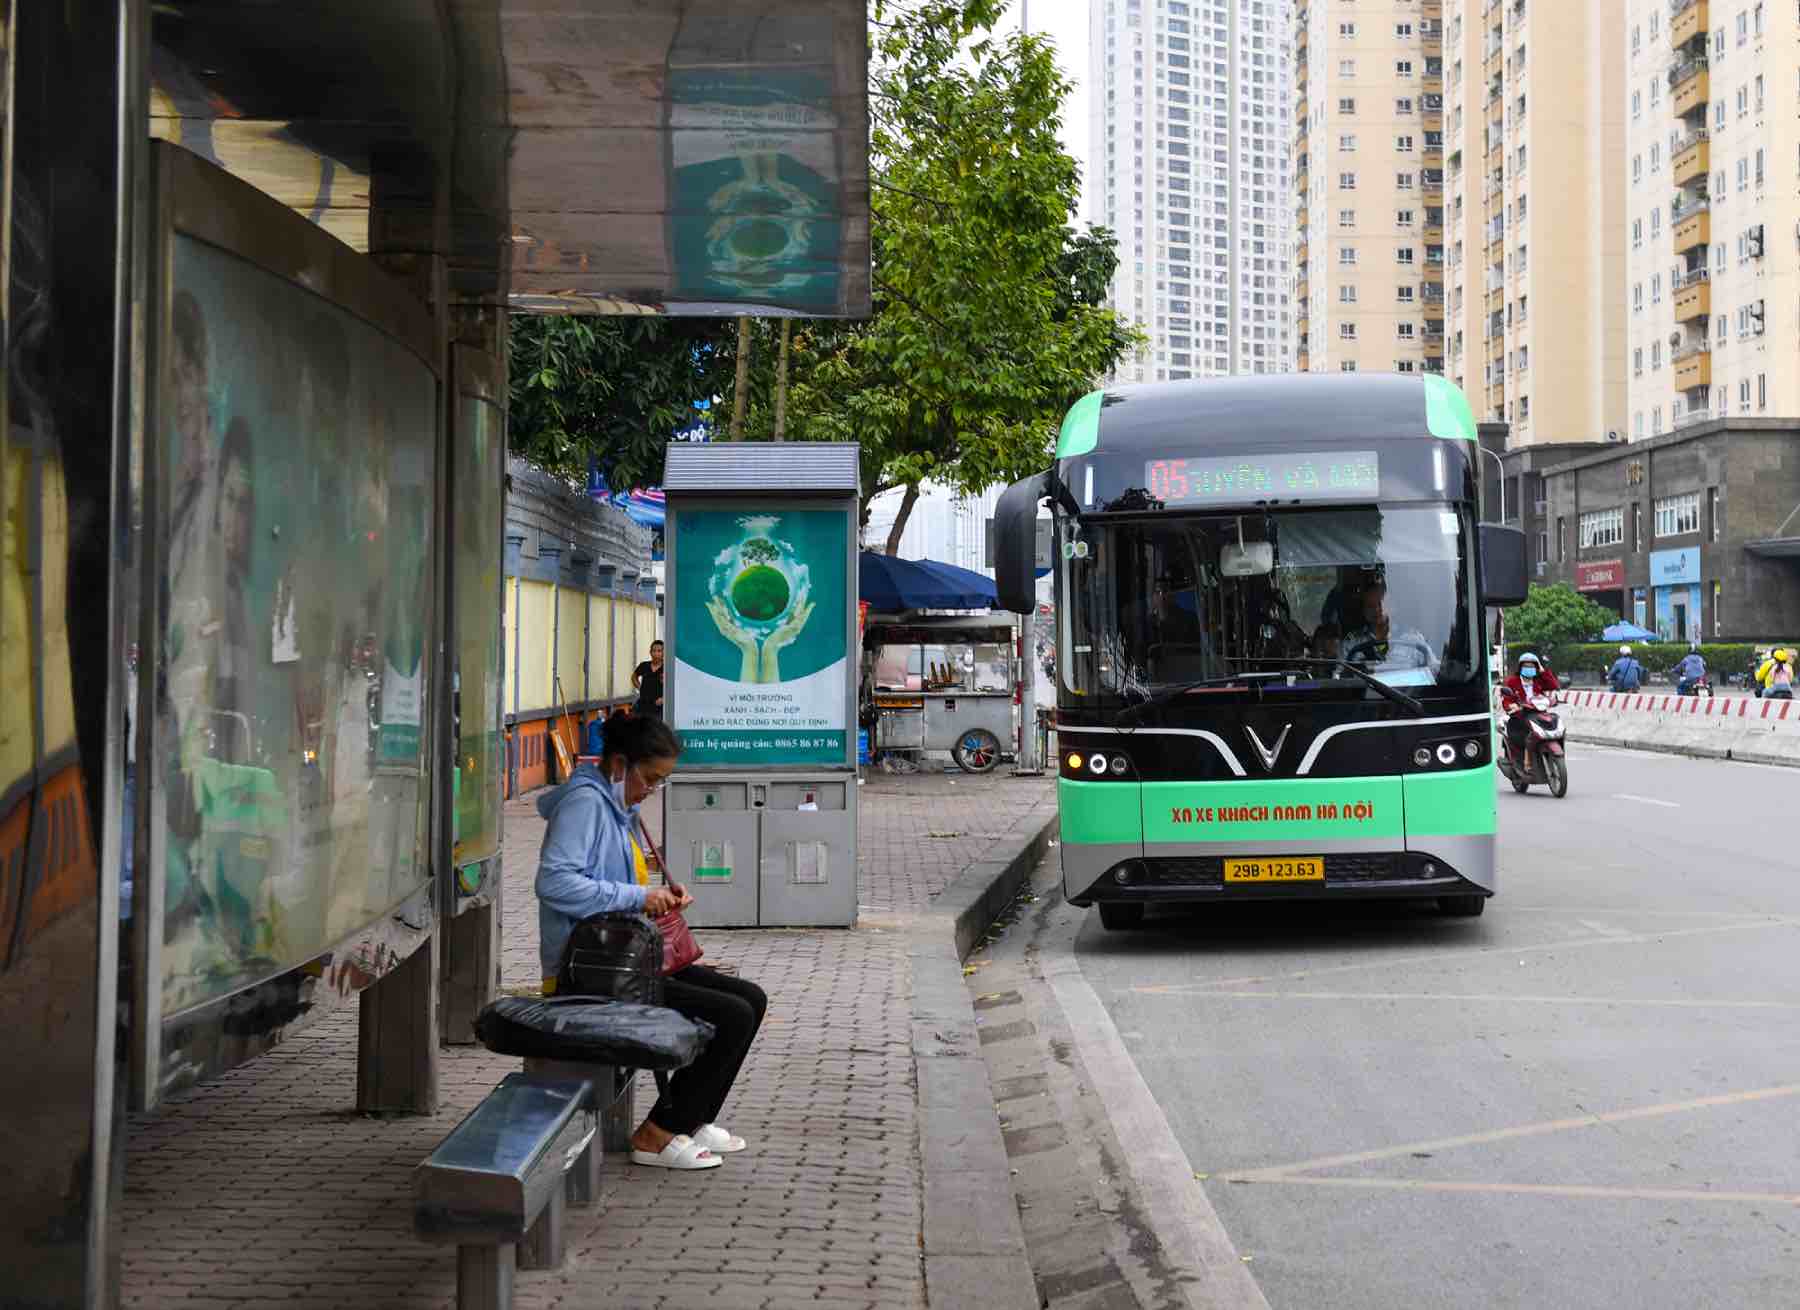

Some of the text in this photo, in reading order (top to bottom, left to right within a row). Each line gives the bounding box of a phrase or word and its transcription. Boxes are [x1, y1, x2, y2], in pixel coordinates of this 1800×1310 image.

[1151, 458, 1188, 500] 05
[707, 737, 718, 751] hệ
[720, 737, 752, 751] quảng
[1196, 807, 1213, 823] XE
[1218, 803, 1268, 823] KHÁCH
[1273, 804, 1312, 821] NAM
[1317, 801, 1338, 820] HÀ
[1343, 800, 1374, 822] NỘI
